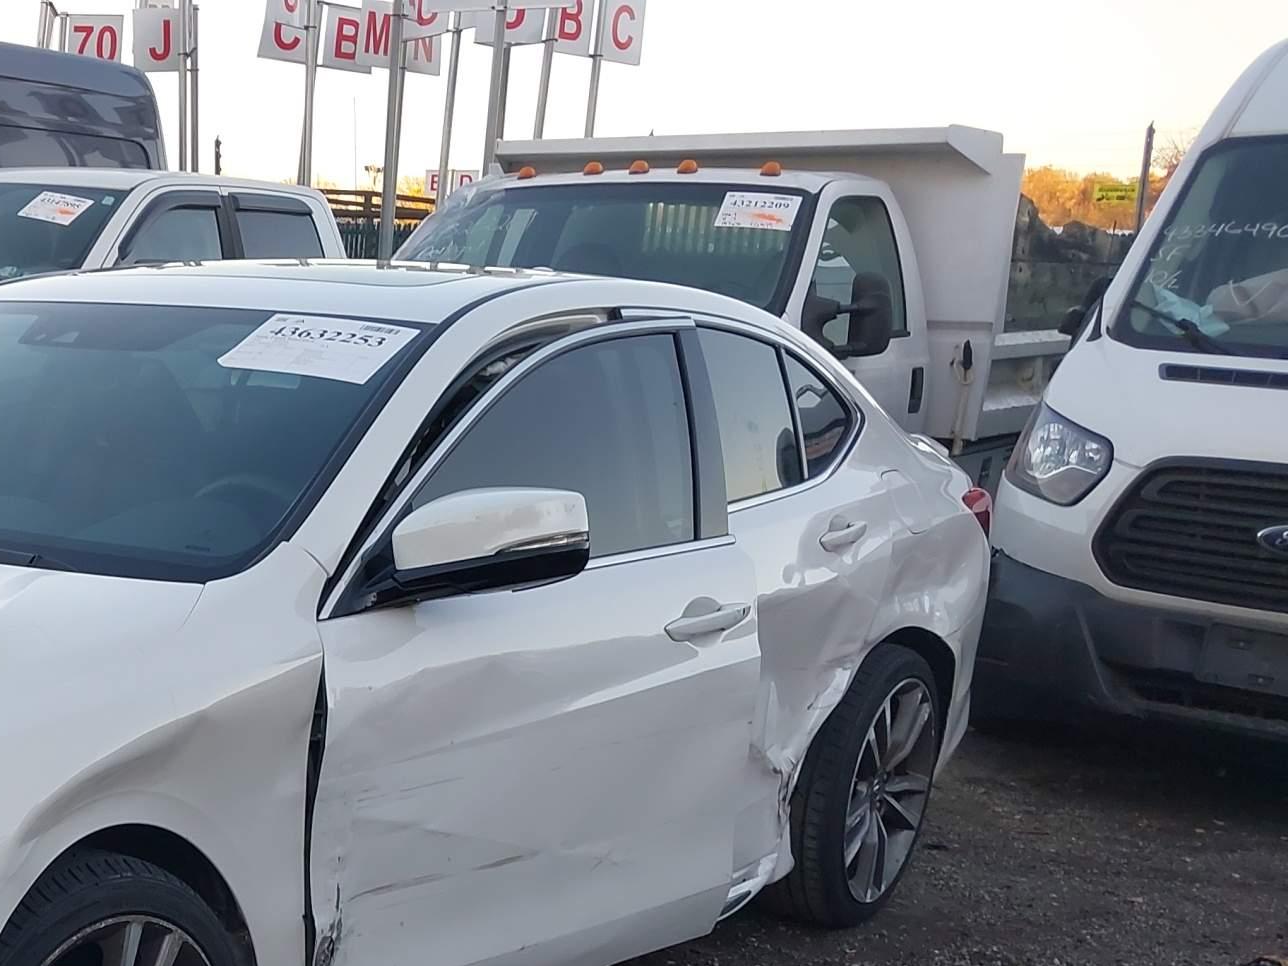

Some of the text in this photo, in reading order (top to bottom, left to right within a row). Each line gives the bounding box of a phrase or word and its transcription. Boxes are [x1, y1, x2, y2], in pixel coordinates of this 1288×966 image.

[73, 25, 117, 60] 70
[149, 19, 171, 61] J
[334, 17, 360, 60] B
[364, 11, 391, 56] M
[612, 5, 635, 50] C
[269, 325, 388, 348] 43632253
